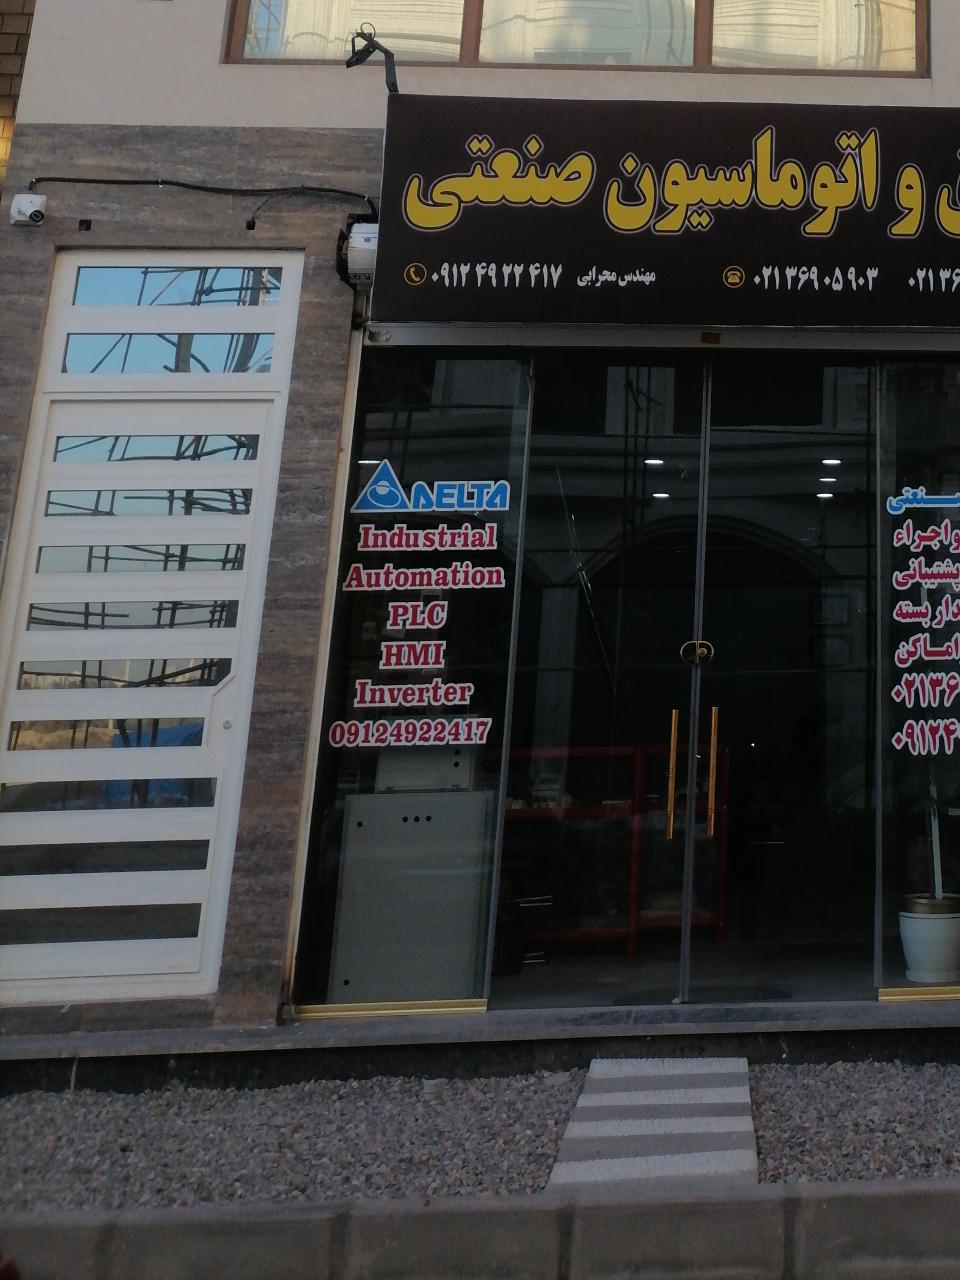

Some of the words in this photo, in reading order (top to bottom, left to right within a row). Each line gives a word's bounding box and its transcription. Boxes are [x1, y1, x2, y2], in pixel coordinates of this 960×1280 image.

[404, 132, 597, 233] صنعتی
[602, 125, 880, 237] اتوماسیون
[888, 162, 924, 238] و
[576, 265, 617, 287] محرابی
[618, 269, 656, 286] مهندس
[411, 480, 510, 510] DELTA
[358, 523, 497, 551] Industrial
[893, 518, 950, 551] اجراء
[343, 561, 505, 591] Automation
[387, 601, 448, 629] PLC
[893, 600, 931, 627] بسته
[380, 641, 446, 669] HMI
[895, 632, 960, 667] اماکن
[354, 678, 474, 707] Inverter
[329, 718, 492, 747] 09124922417
